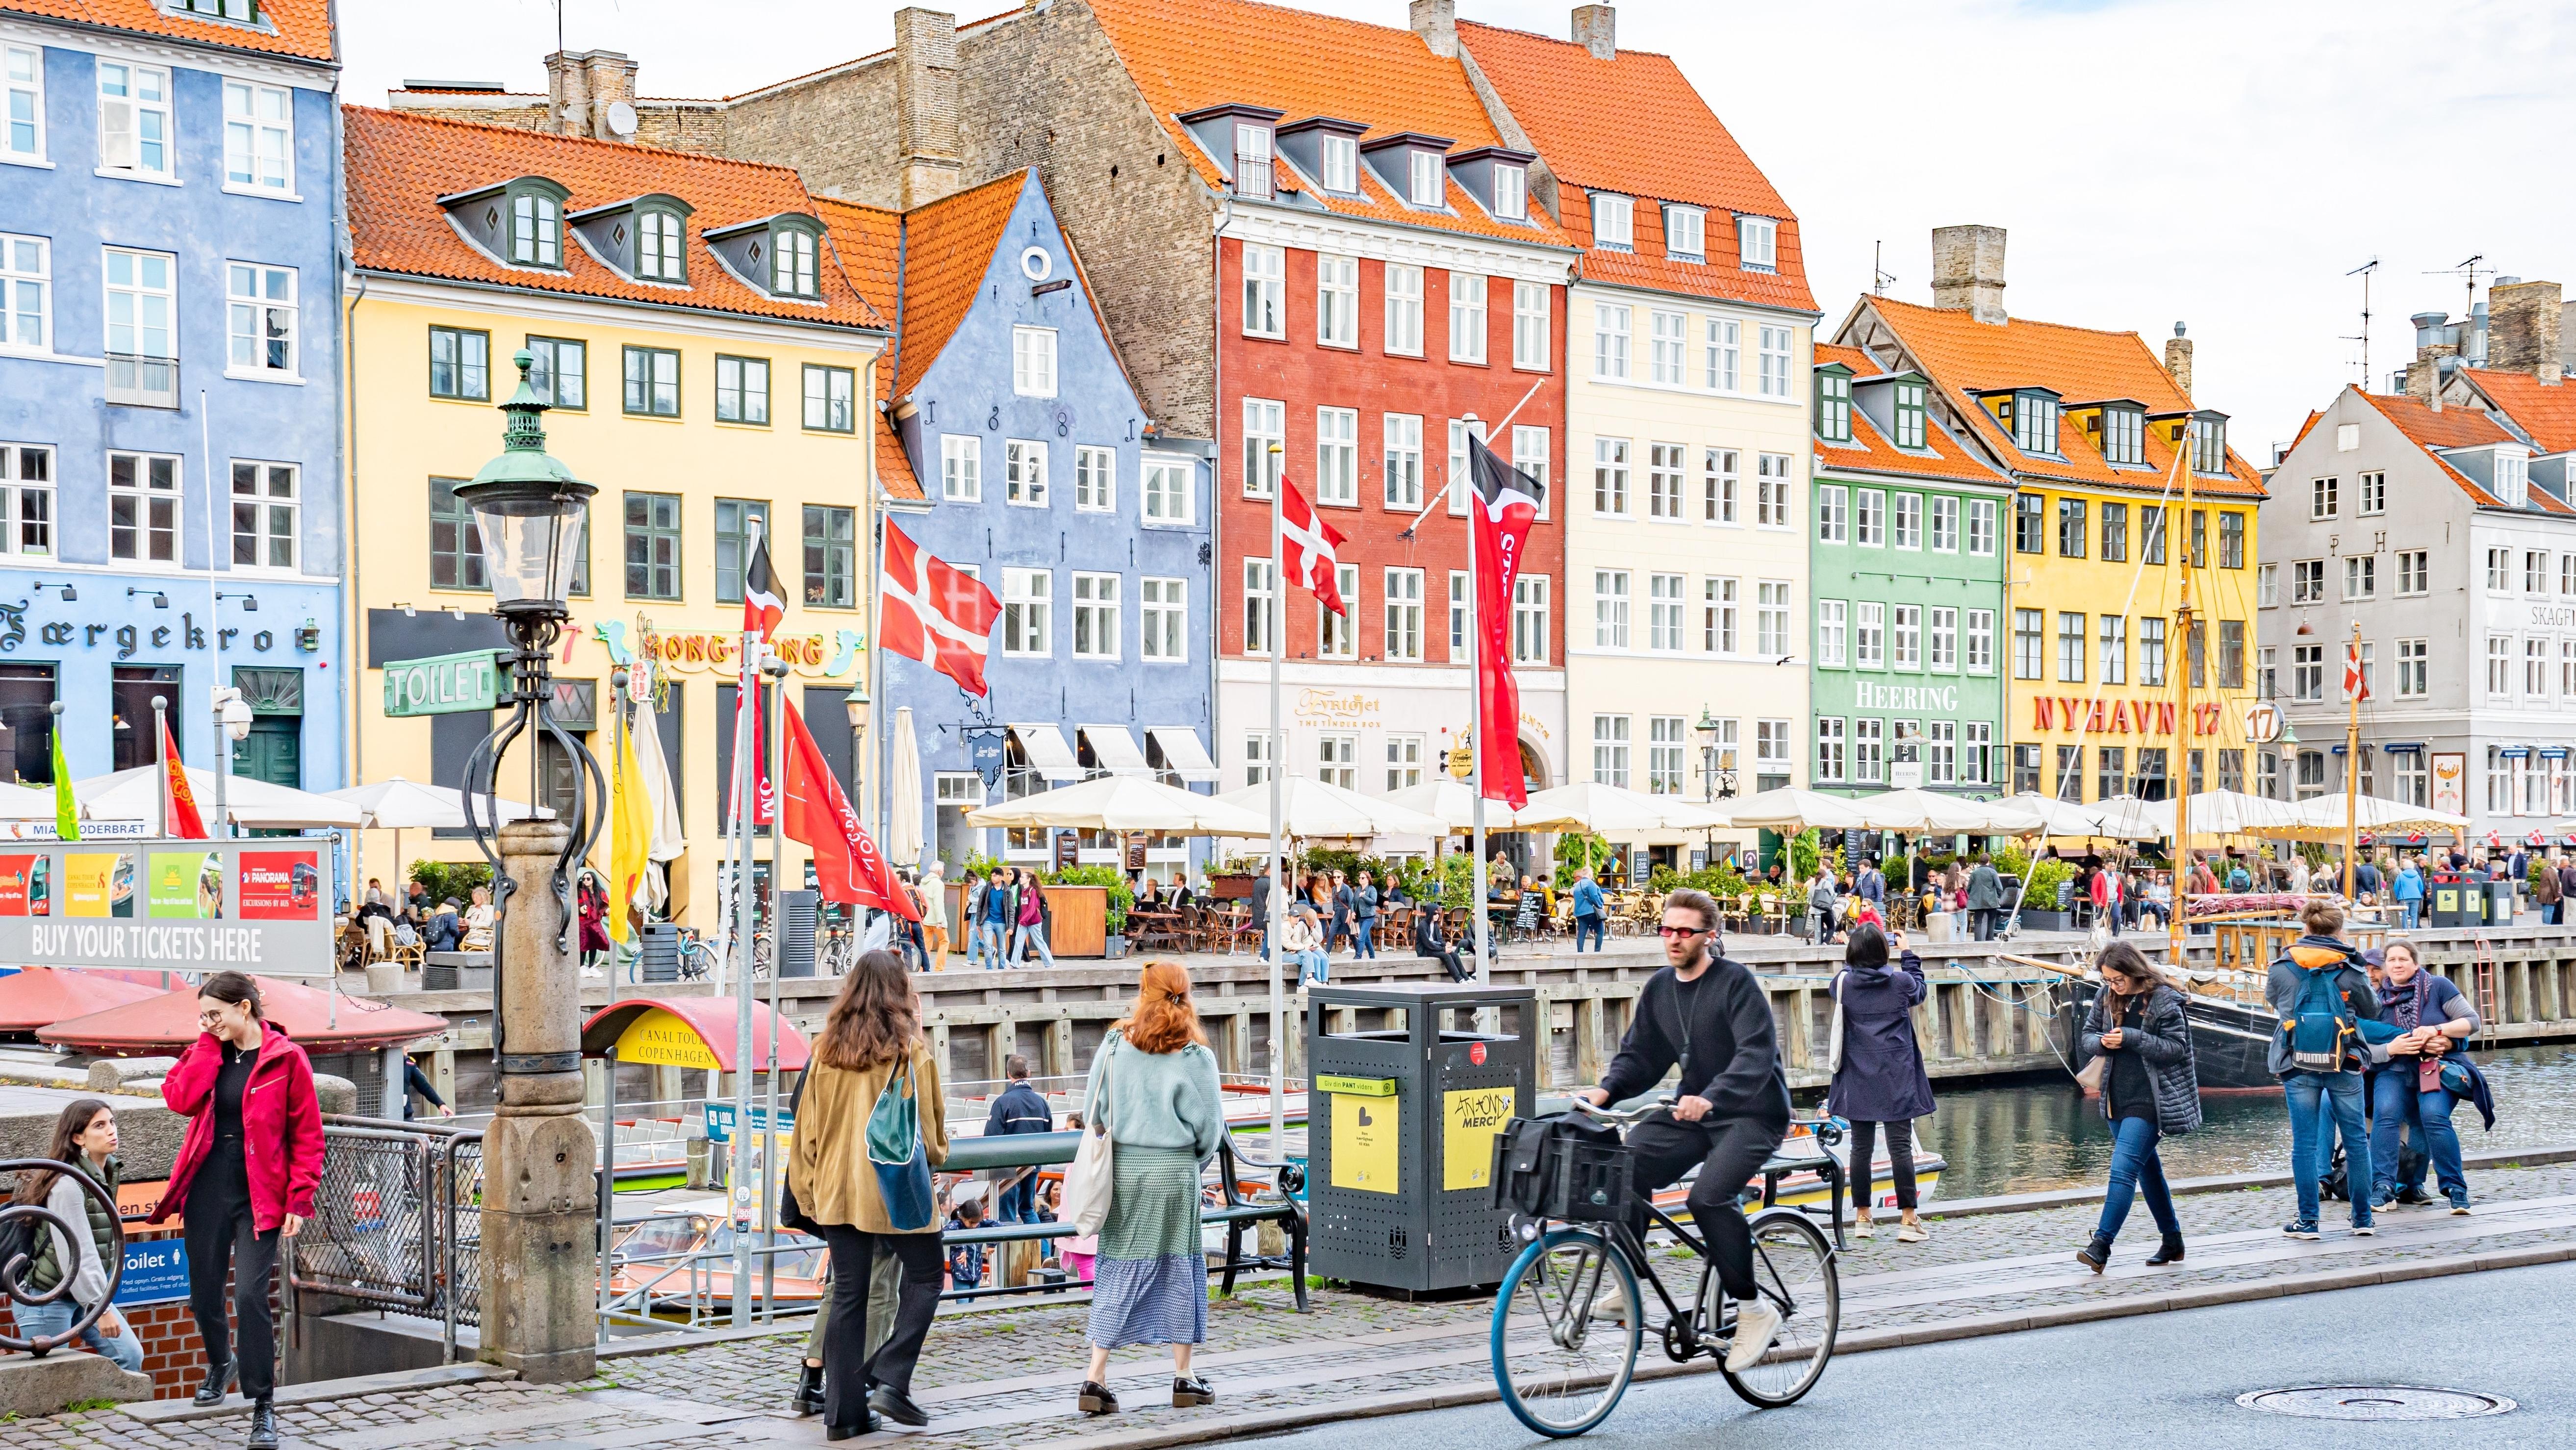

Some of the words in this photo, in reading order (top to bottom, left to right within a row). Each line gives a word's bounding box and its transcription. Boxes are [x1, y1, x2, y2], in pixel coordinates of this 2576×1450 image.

[387, 660, 488, 707] TOILET
[1855, 681, 1959, 711] HEERING
[2034, 696, 2176, 734] NYHAVN
[2193, 702, 2222, 736] 17
[2247, 709, 2273, 739] 17
[252, 872, 290, 883] PANORAMA
[32, 924, 69, 956] BUY
[74, 925, 125, 958] YOUR
[129, 926, 205, 960] TICKETS
[211, 928, 262, 962] HERE
[640, 1029, 674, 1043] CANAL
[638, 1046, 712, 1063] COPENHAGEN
[2295, 1052, 2330, 1064] PUMA
[719, 1111, 733, 1125] LOOK
[1462, 1116, 1496, 1128] MERCI
[120, 1203, 139, 1215] en
